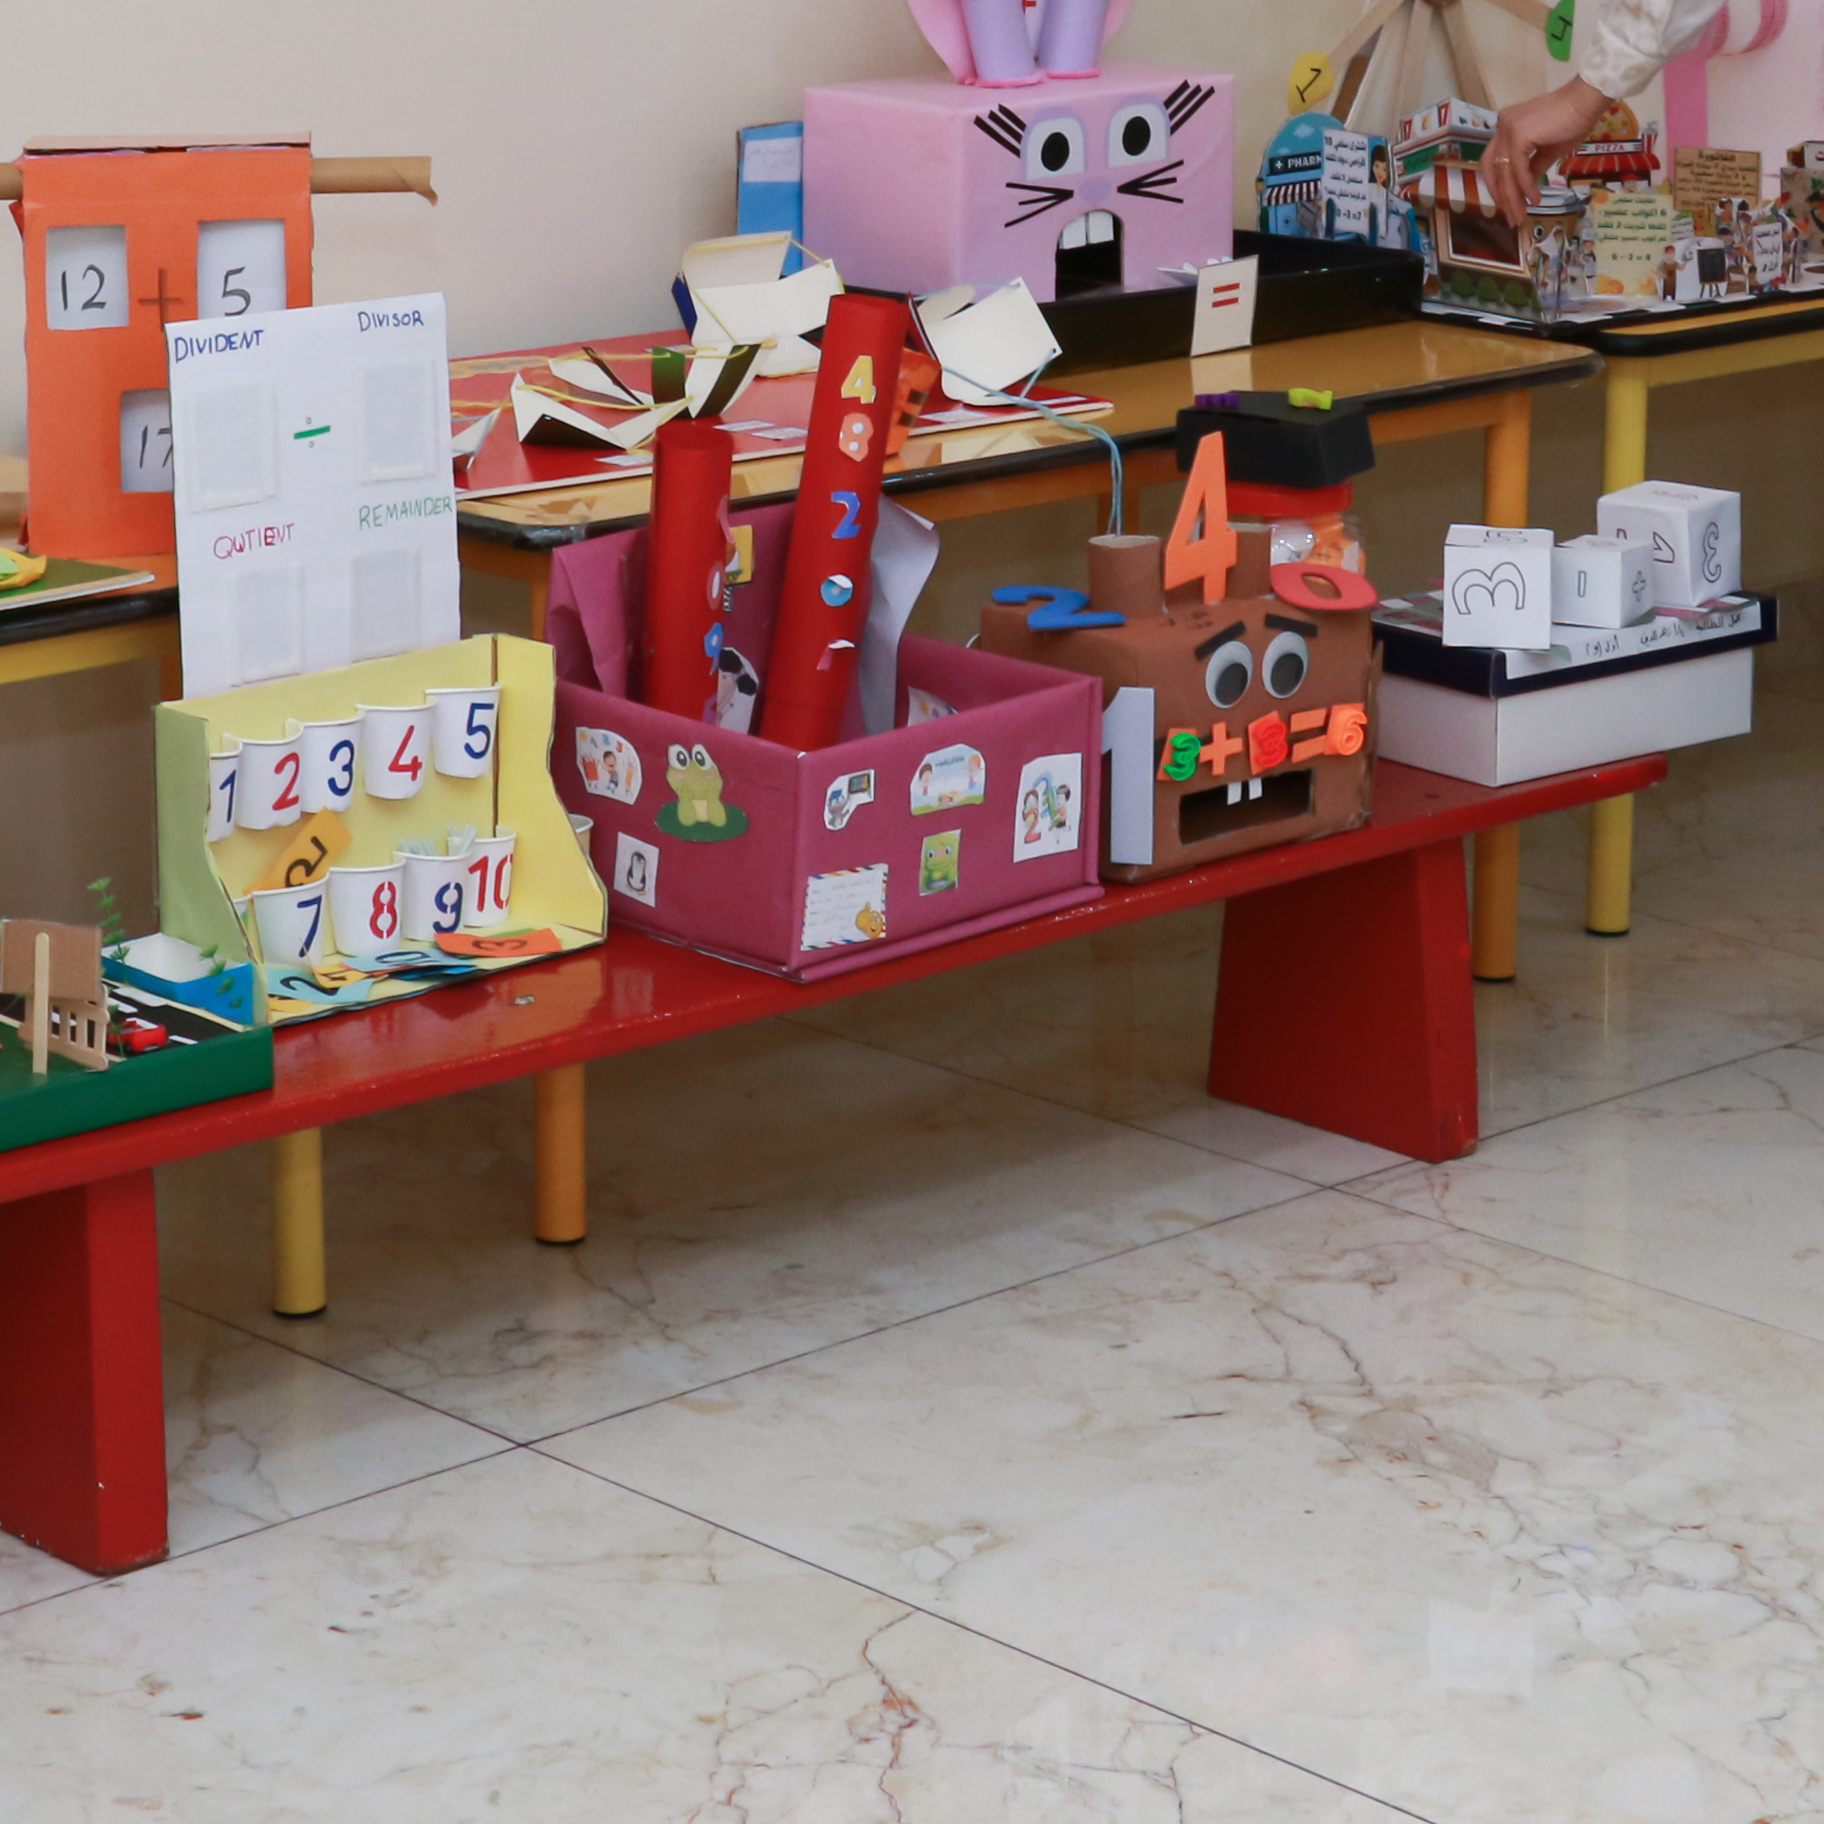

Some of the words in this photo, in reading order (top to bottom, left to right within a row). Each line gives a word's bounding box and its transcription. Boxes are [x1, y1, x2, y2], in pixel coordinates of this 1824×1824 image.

[1595, 144, 1625, 152] PIZZA
[60, 263, 107, 311] 12
[221, 266, 252, 317] 5
[174, 329, 264, 364] DIVIDENT
[357, 310, 425, 332] DIVISOR
[841, 355, 877, 405] 4
[358, 496, 454, 531] REMAINDER
[831, 490, 861, 539] 2
[1163, 431, 1238, 605] 4
[990, 585, 1127, 632] 2
[388, 725, 423, 782] 4
[464, 702, 495, 760] 5
[218, 768, 237, 823] 1
[271, 751, 301, 811] 2
[328, 740, 355, 797] 3
[1101, 686, 1155, 865] 1
[369, 880, 398, 940] 8
[433, 880, 463, 934] 9
[468, 853, 514, 913] 10
[297, 894, 323, 958] 7
